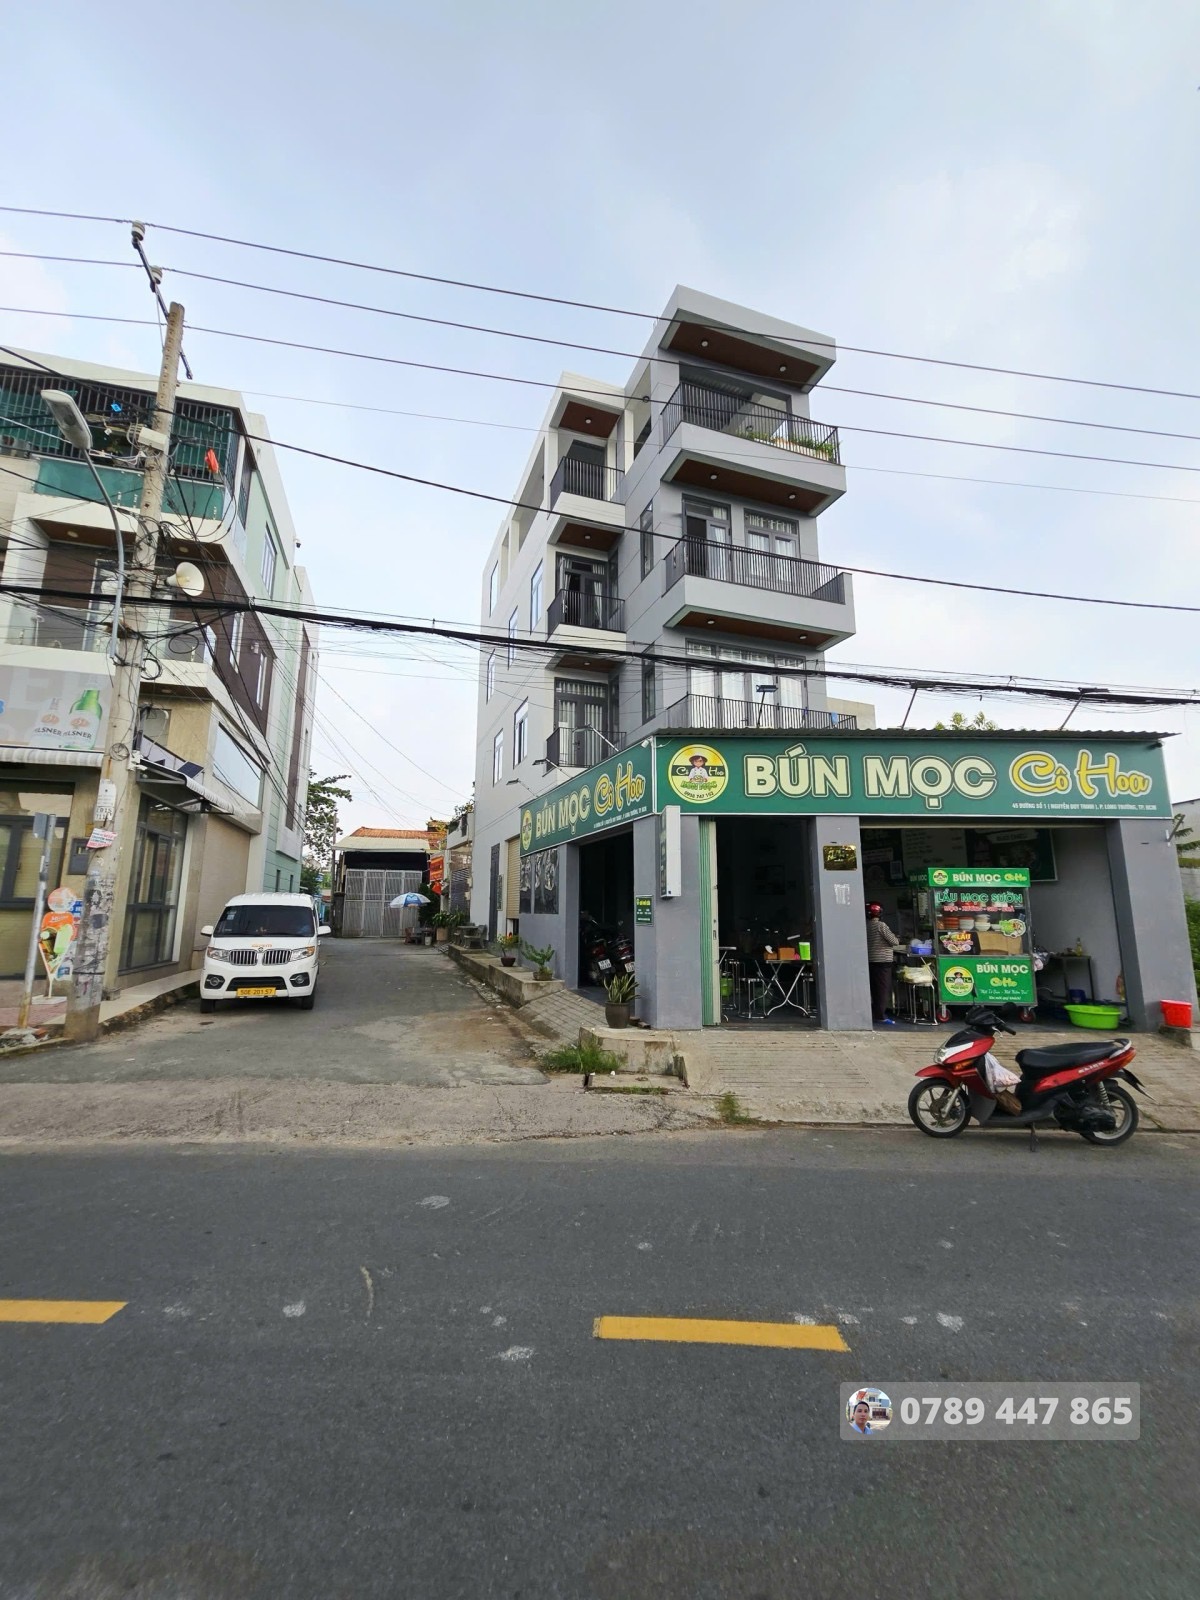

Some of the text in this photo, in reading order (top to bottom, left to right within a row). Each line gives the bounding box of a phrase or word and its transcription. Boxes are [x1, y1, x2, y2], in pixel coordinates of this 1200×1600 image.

[744, 743, 1152, 809] BÚN MỌC Cô Hoa
[535, 799, 556, 839] BÚN
[558, 785, 591, 835] MỌC
[594, 774, 614, 816] Cô
[615, 761, 646, 811] Hoa
[952, 872, 973, 882] BÚN
[976, 874, 1001, 883] MỌC
[961, 893, 989, 904] MỌC
[976, 962, 1029, 976] BÚN MỌC
